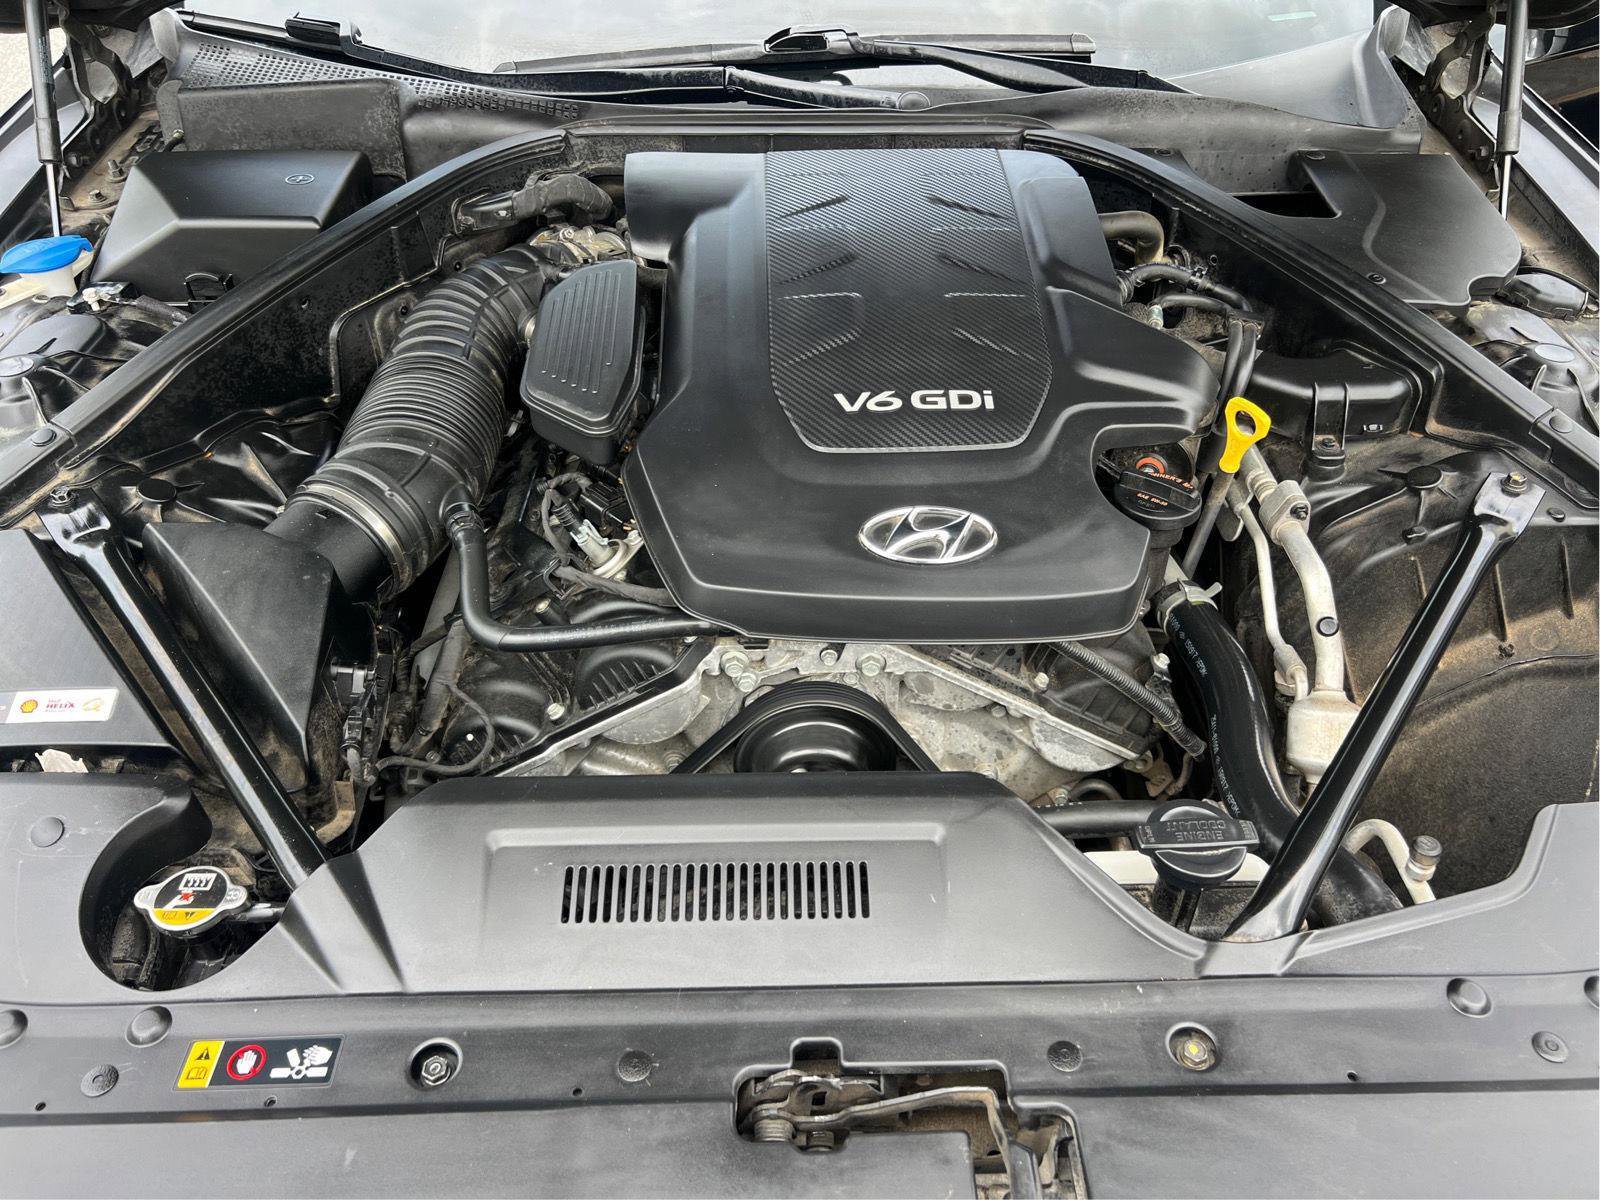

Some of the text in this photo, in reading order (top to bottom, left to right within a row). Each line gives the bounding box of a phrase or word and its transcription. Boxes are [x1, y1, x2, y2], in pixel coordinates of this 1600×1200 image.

[833, 389, 995, 412] V6 GDi
[1166, 820, 1226, 832] COOLANT
[1174, 830, 1225, 842] ENGINE
